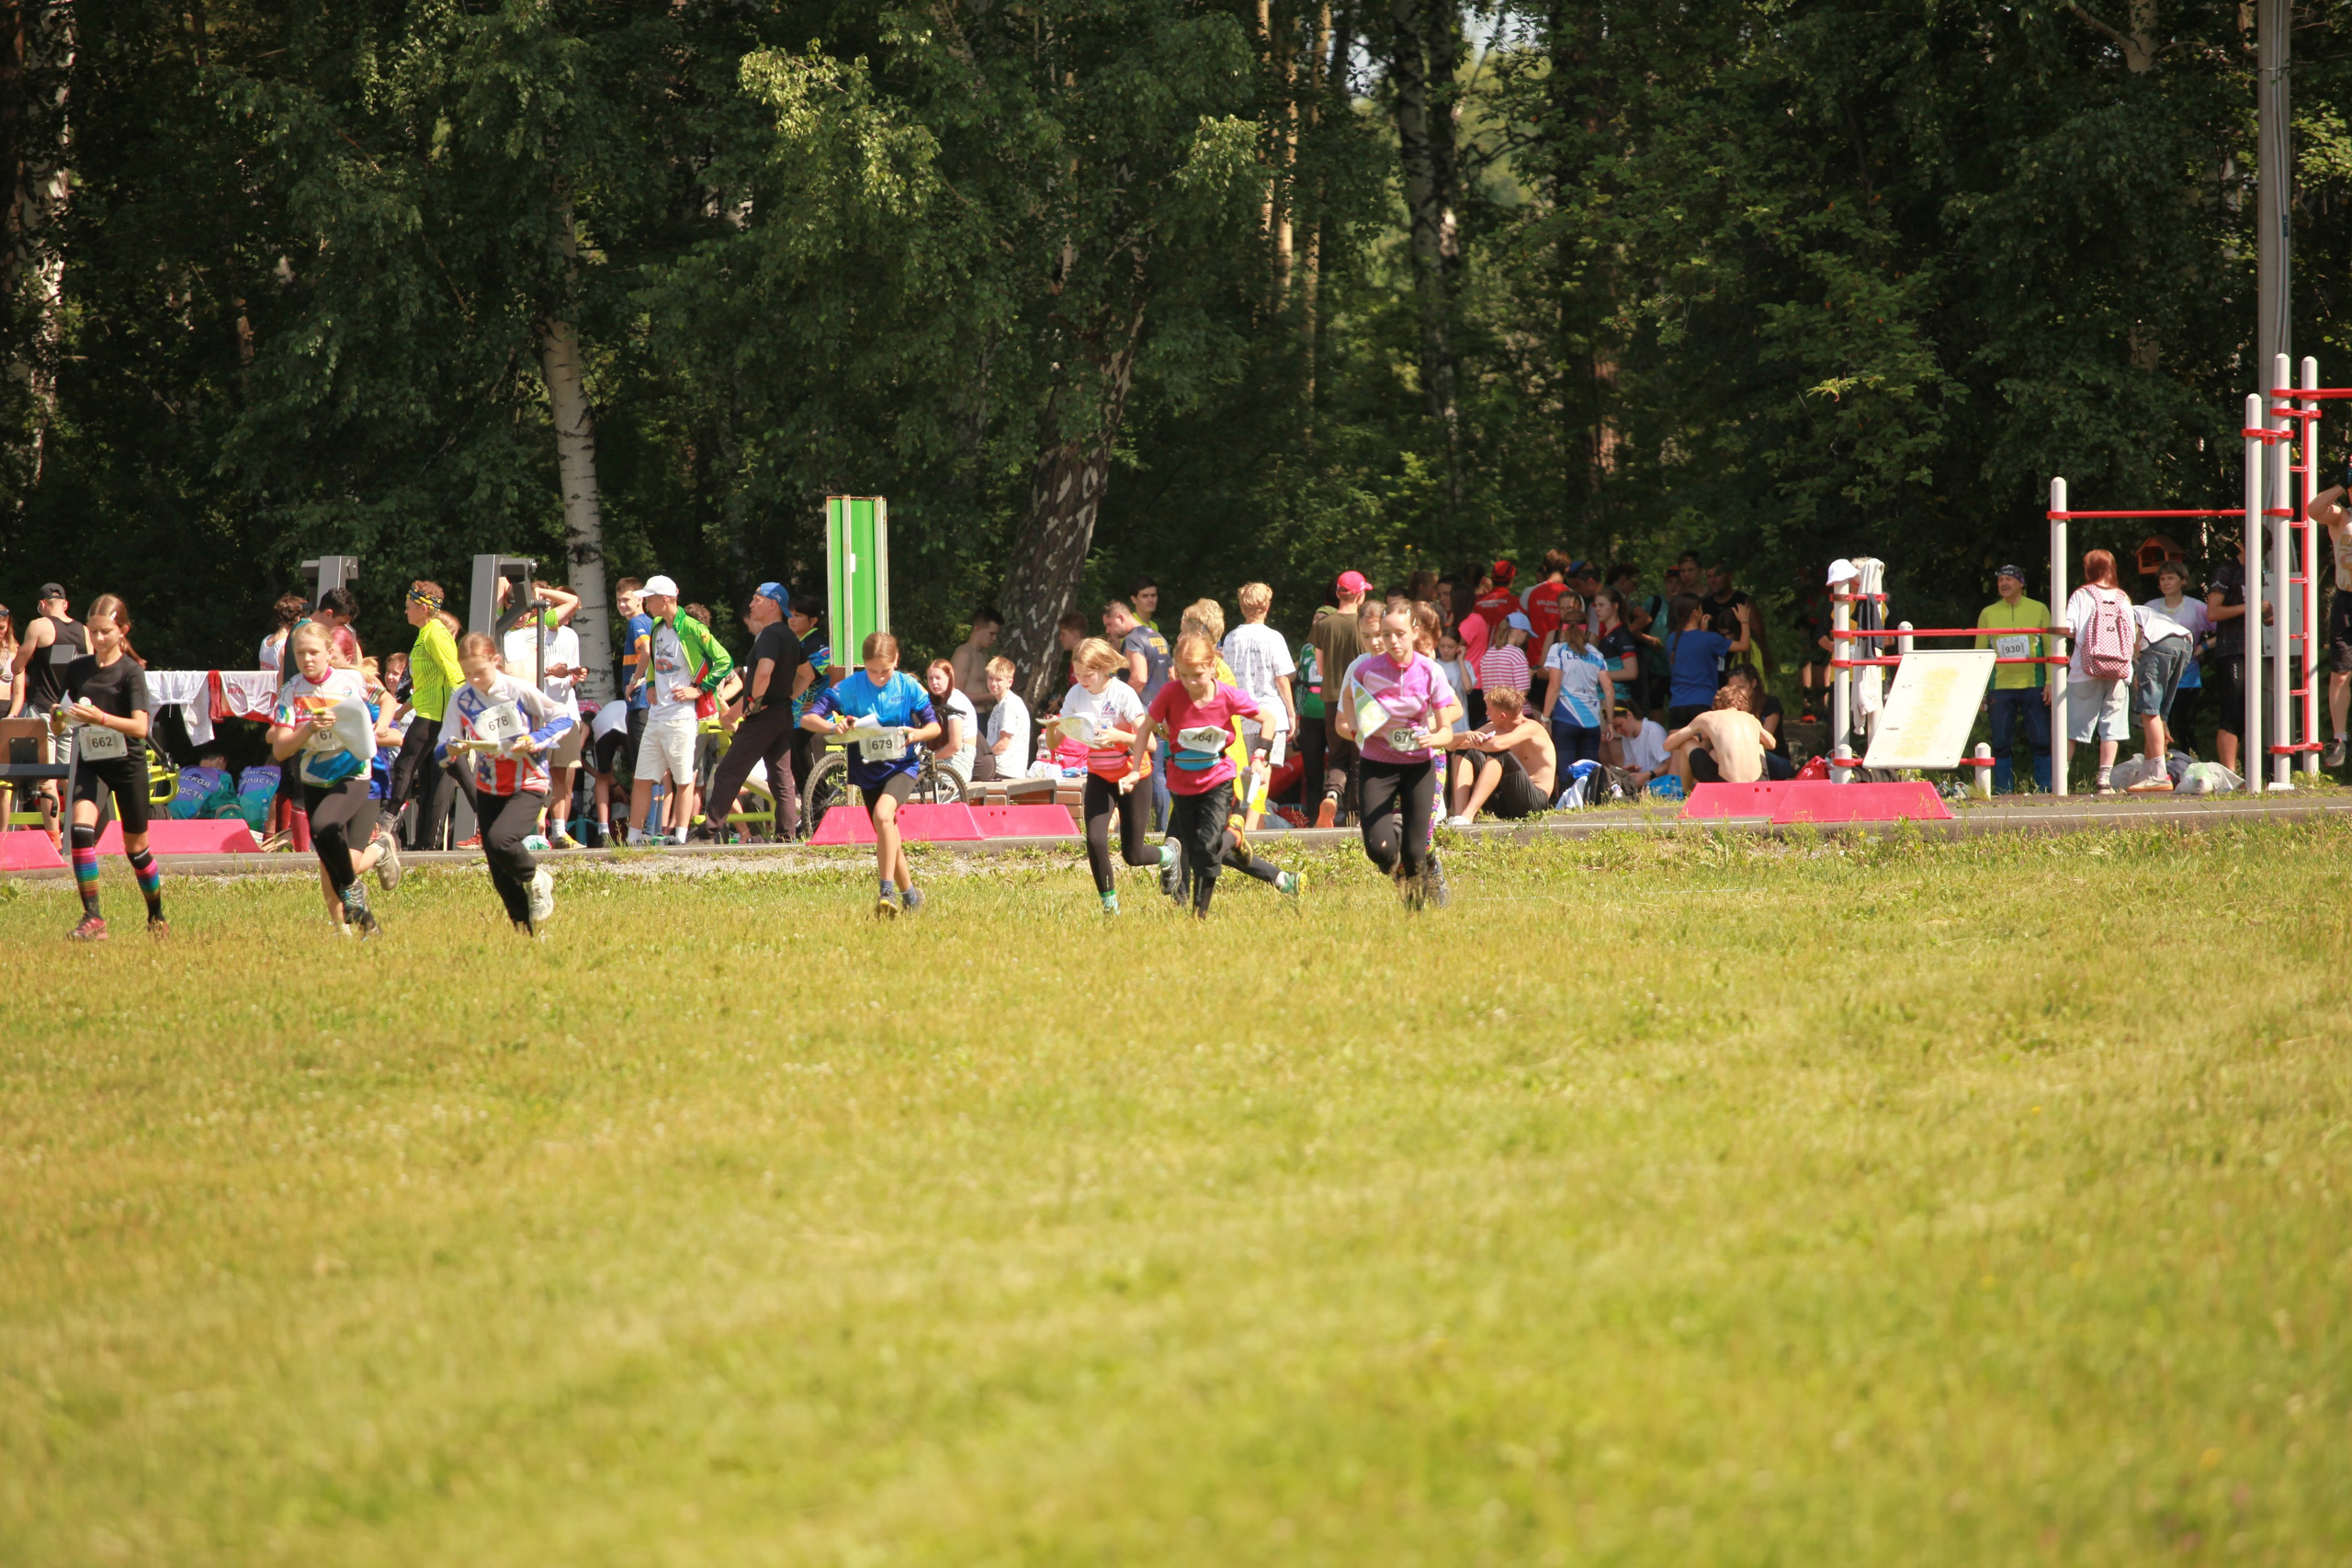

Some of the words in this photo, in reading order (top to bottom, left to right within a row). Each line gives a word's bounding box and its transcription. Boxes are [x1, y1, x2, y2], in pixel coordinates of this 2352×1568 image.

[2005, 645, 2021, 653] 930
[488, 716, 509, 731] 678
[320, 729, 333, 740] 67
[92, 736, 113, 748] 662
[872, 739, 893, 750] 679
